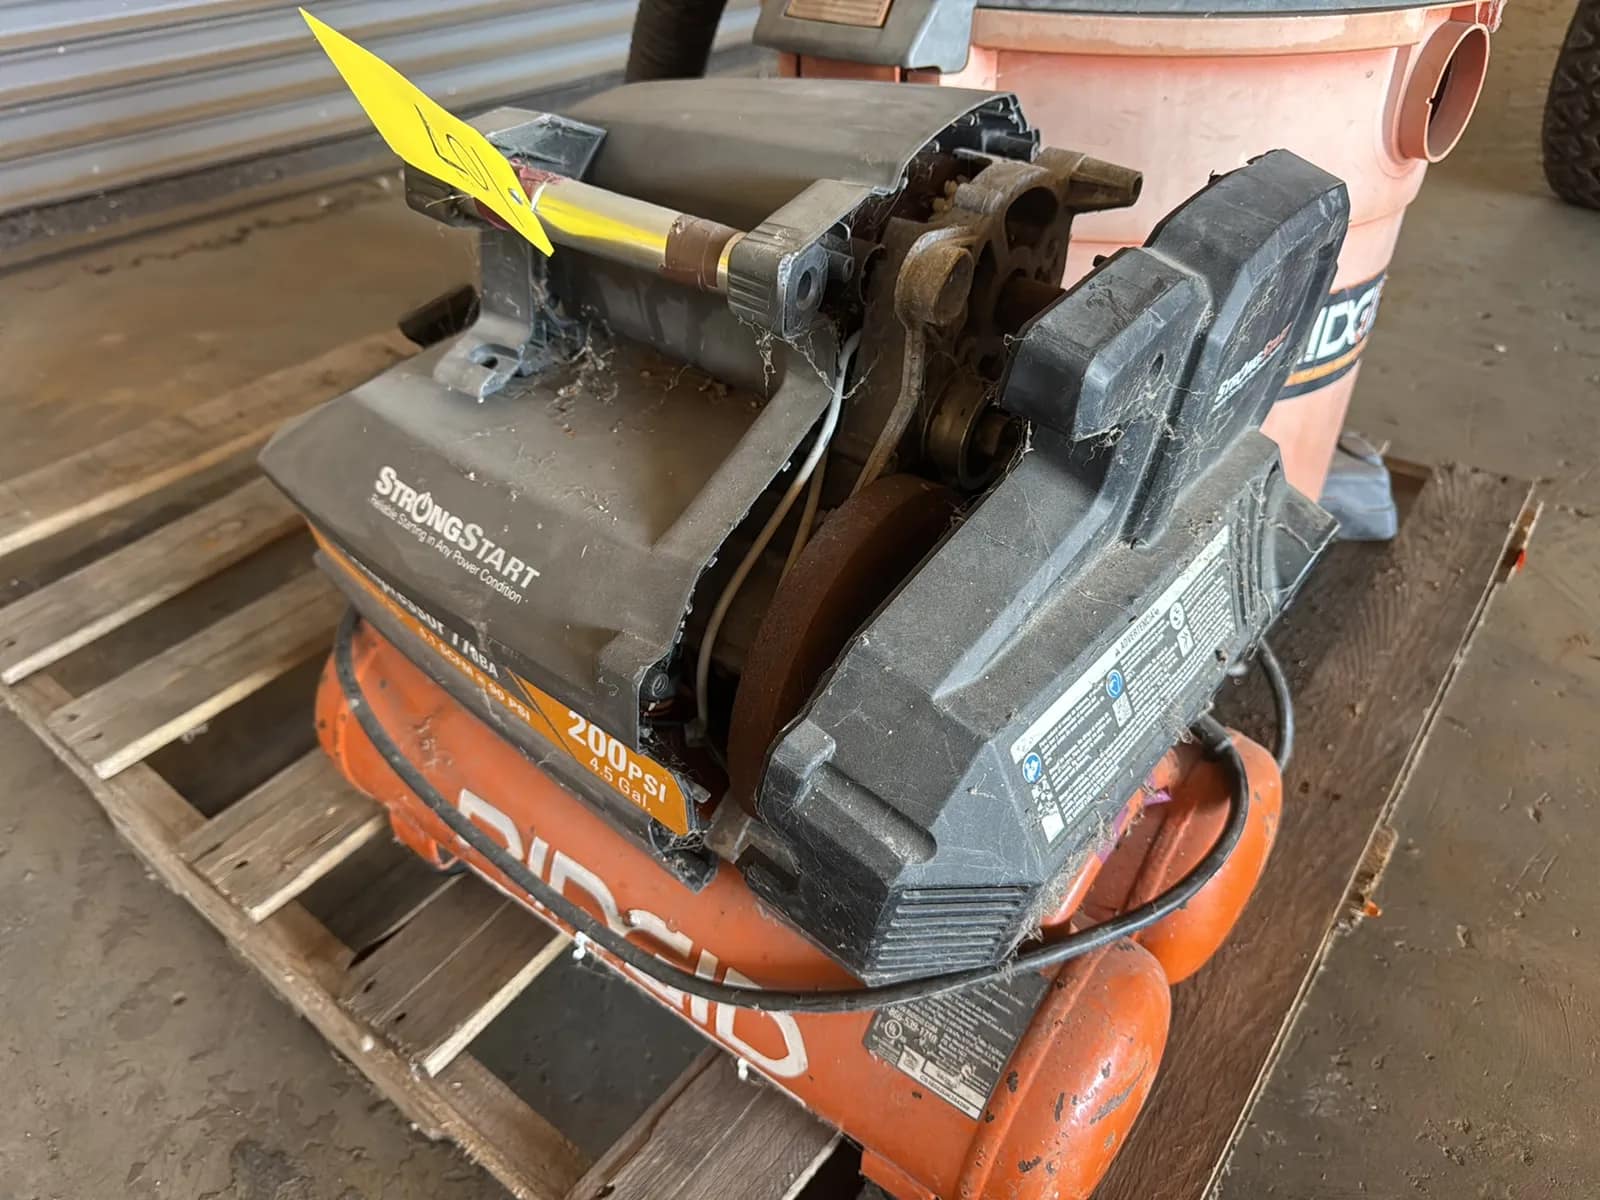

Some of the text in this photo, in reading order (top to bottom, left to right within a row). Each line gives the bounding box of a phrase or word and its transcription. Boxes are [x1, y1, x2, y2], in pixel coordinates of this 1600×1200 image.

[426, 534, 436, 546] in
[435, 539, 453, 559] Any
[452, 550, 480, 576] Power
[479, 568, 522, 604] Condition
[590, 757, 652, 812] 4.5 Gal.
